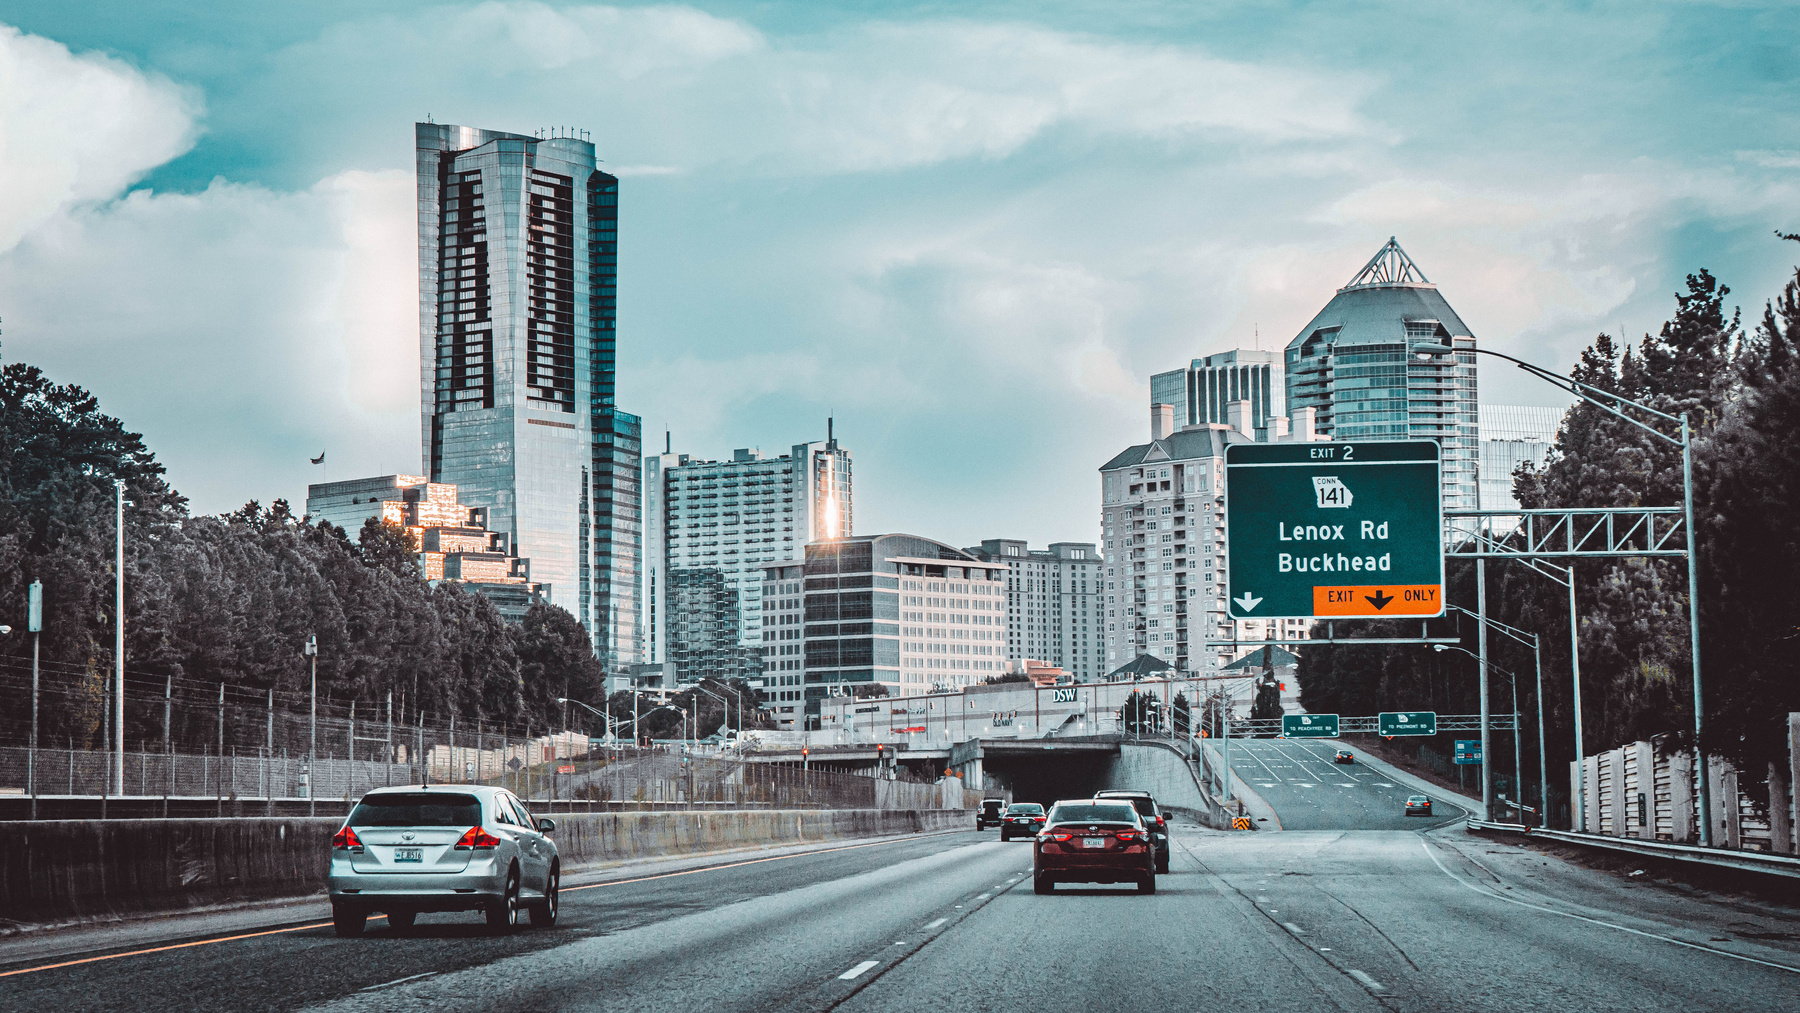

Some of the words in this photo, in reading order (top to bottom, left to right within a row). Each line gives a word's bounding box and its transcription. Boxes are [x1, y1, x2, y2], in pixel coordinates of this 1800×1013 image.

[1310, 448, 1335, 459] EXIT
[1343, 445, 1354, 460] 2
[1319, 487, 1345, 505] 141
[1279, 521, 1345, 541] Lenox
[1361, 520, 1389, 540] Rd
[1279, 552, 1391, 573] Buckhead
[1328, 590, 1354, 603] EXIT
[1404, 589, 1436, 602] ONLY
[1052, 688, 1076, 702] DSW
[993, 719, 1001, 727] OLD
[1002, 719, 1013, 727] NAVY
